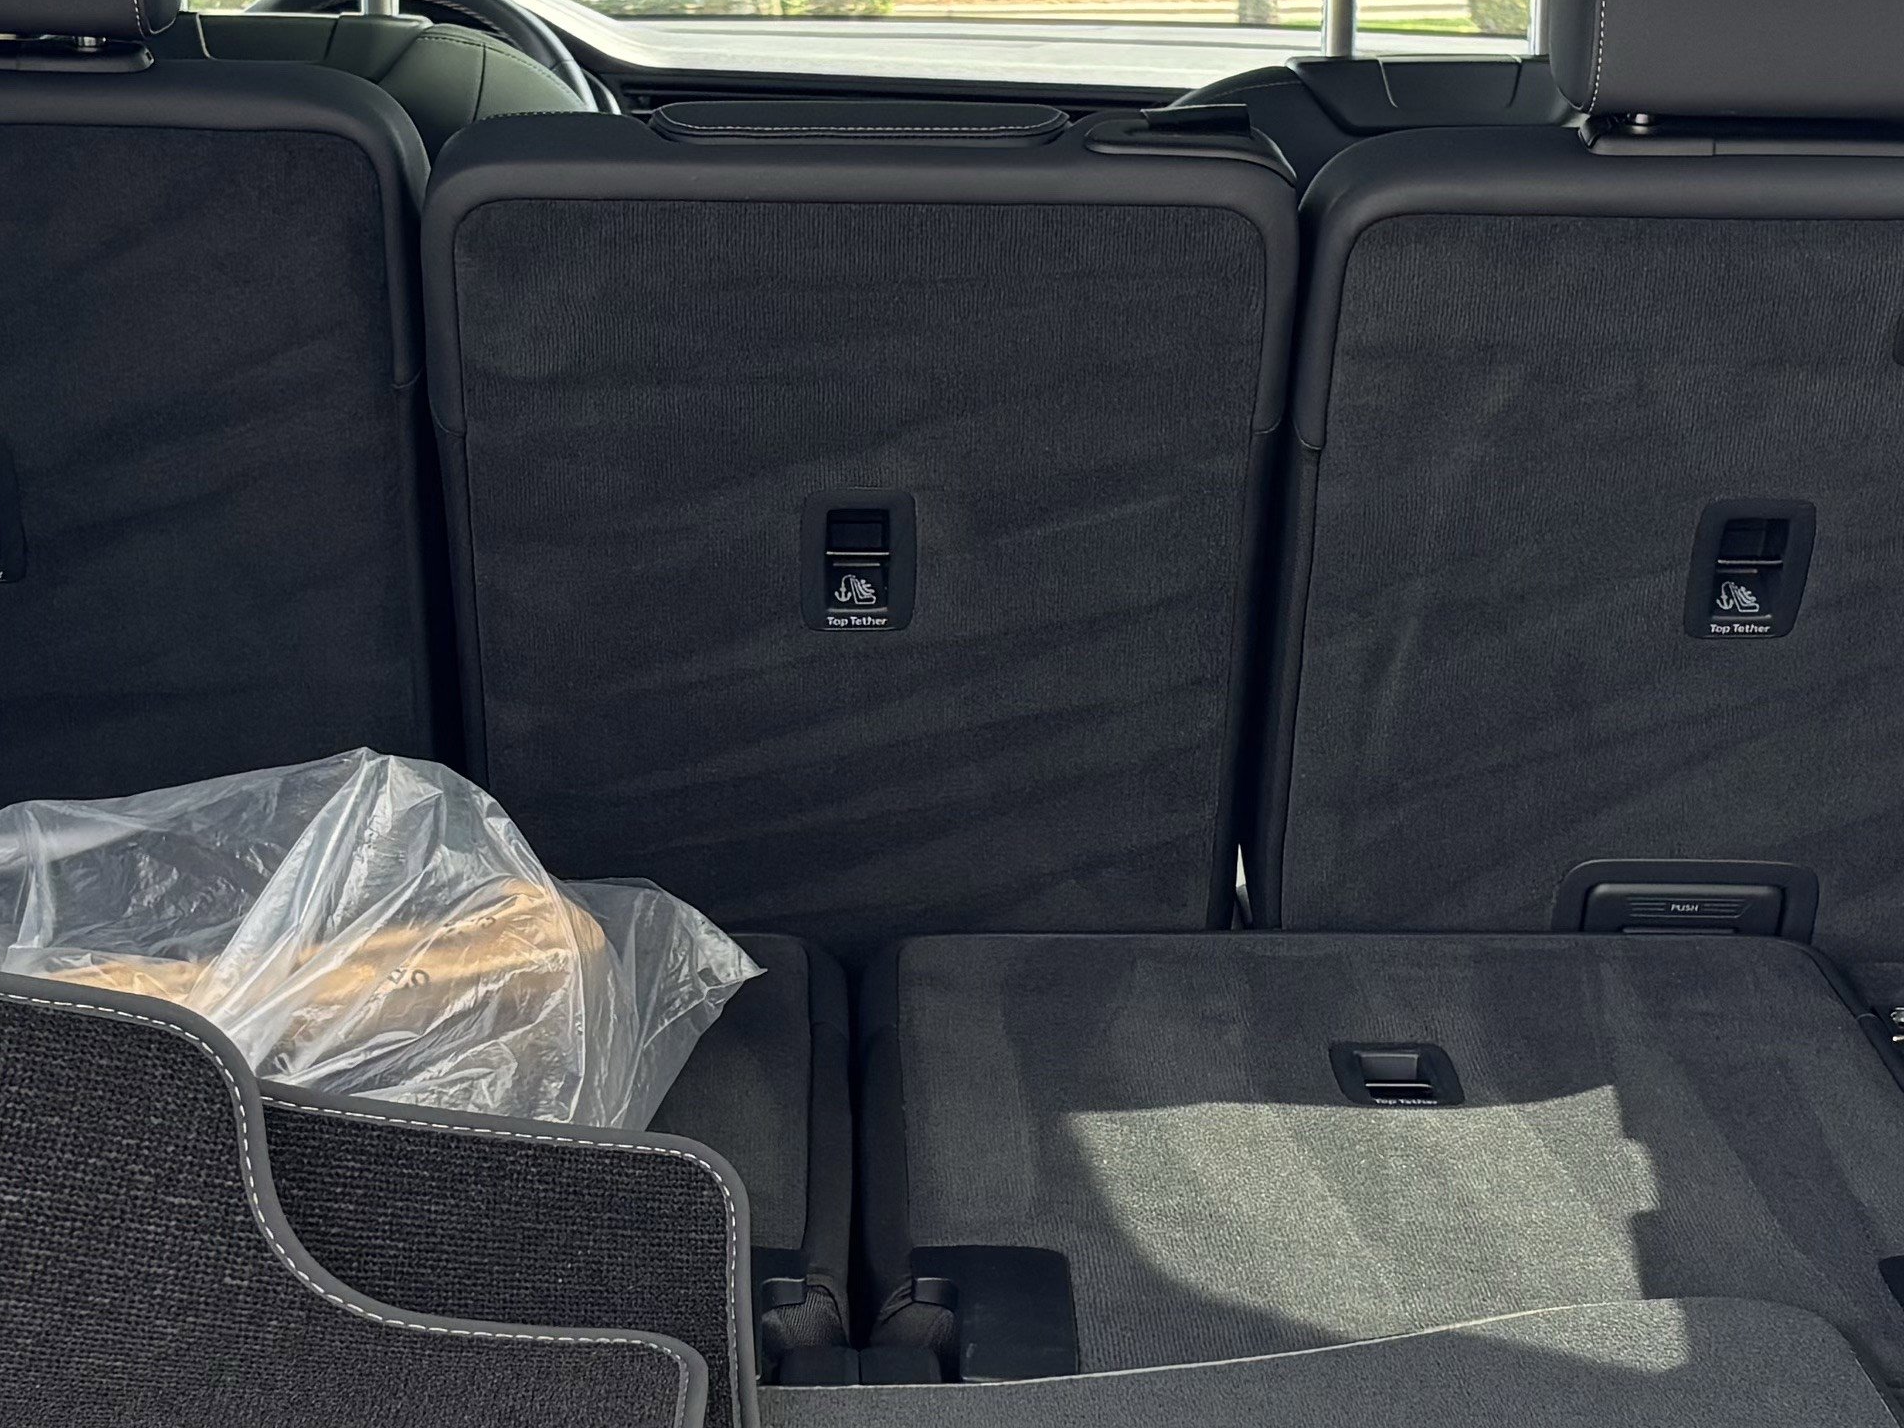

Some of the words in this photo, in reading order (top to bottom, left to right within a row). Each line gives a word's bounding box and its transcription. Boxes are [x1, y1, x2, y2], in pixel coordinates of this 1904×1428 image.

[827, 616, 849, 627] Top
[850, 616, 888, 626] Tether
[1710, 623, 1731, 634] Top
[1732, 623, 1771, 633] Tether
[1670, 903, 1699, 912] PUSH
